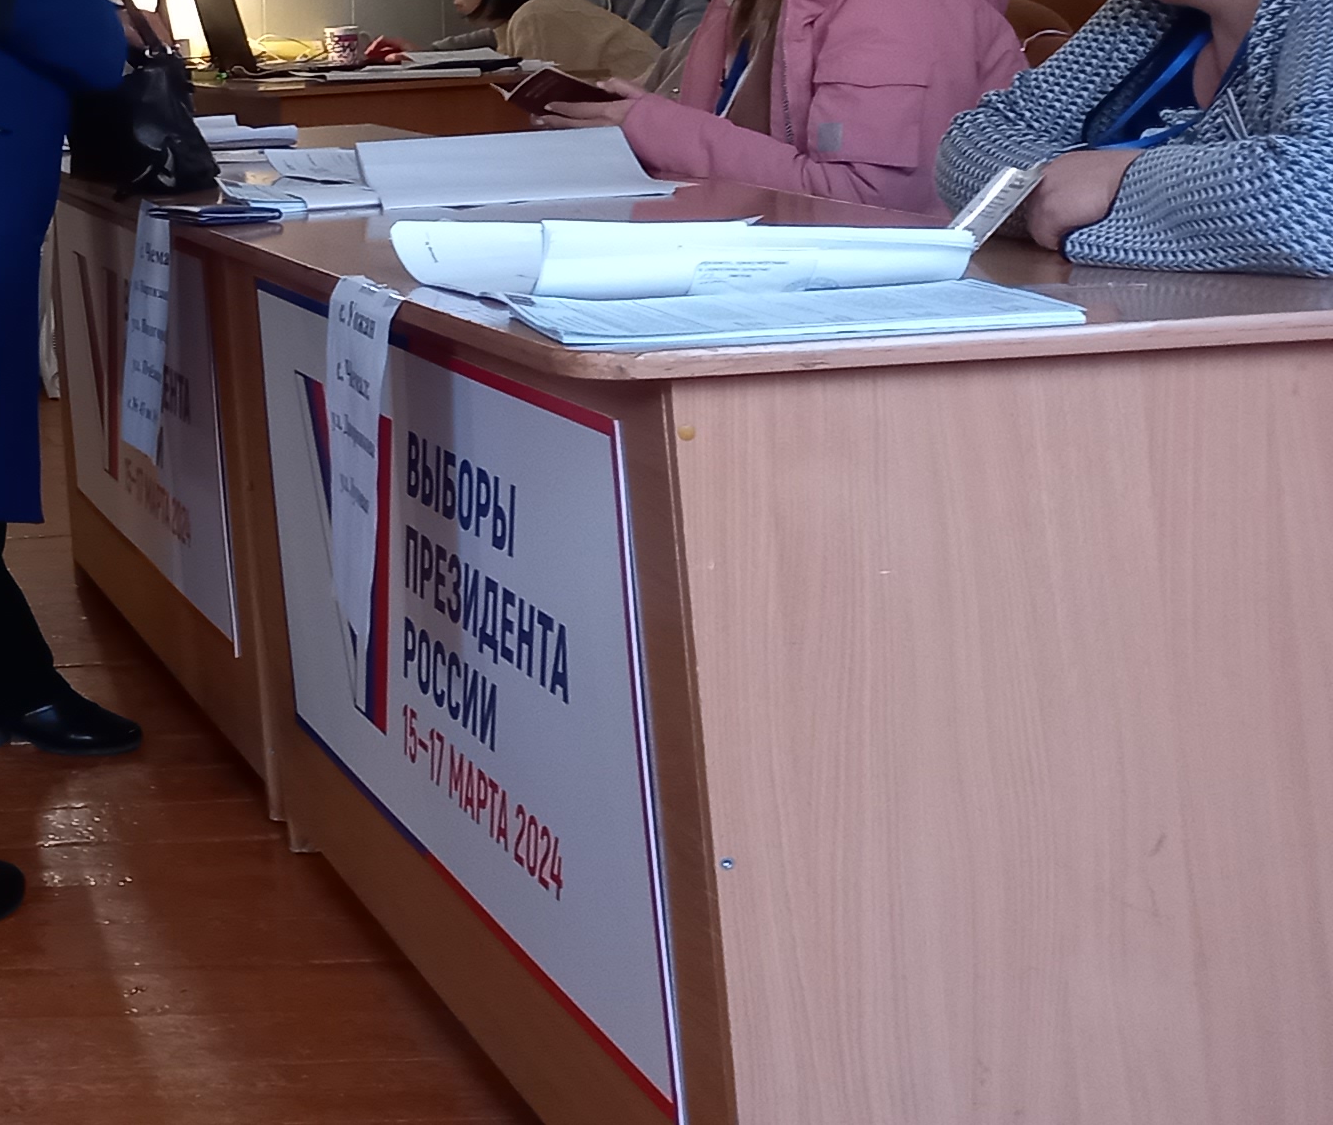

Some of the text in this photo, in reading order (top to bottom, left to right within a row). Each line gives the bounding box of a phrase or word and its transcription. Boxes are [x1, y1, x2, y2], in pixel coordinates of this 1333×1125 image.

[407, 431, 517, 558] ВЫБОРЫ
[404, 617, 497, 751] РОССИИ
[405, 525, 570, 705] ПРЕЗИДЕНТА
[448, 747, 509, 852] МАРТА
[514, 803, 564, 901] 2024
